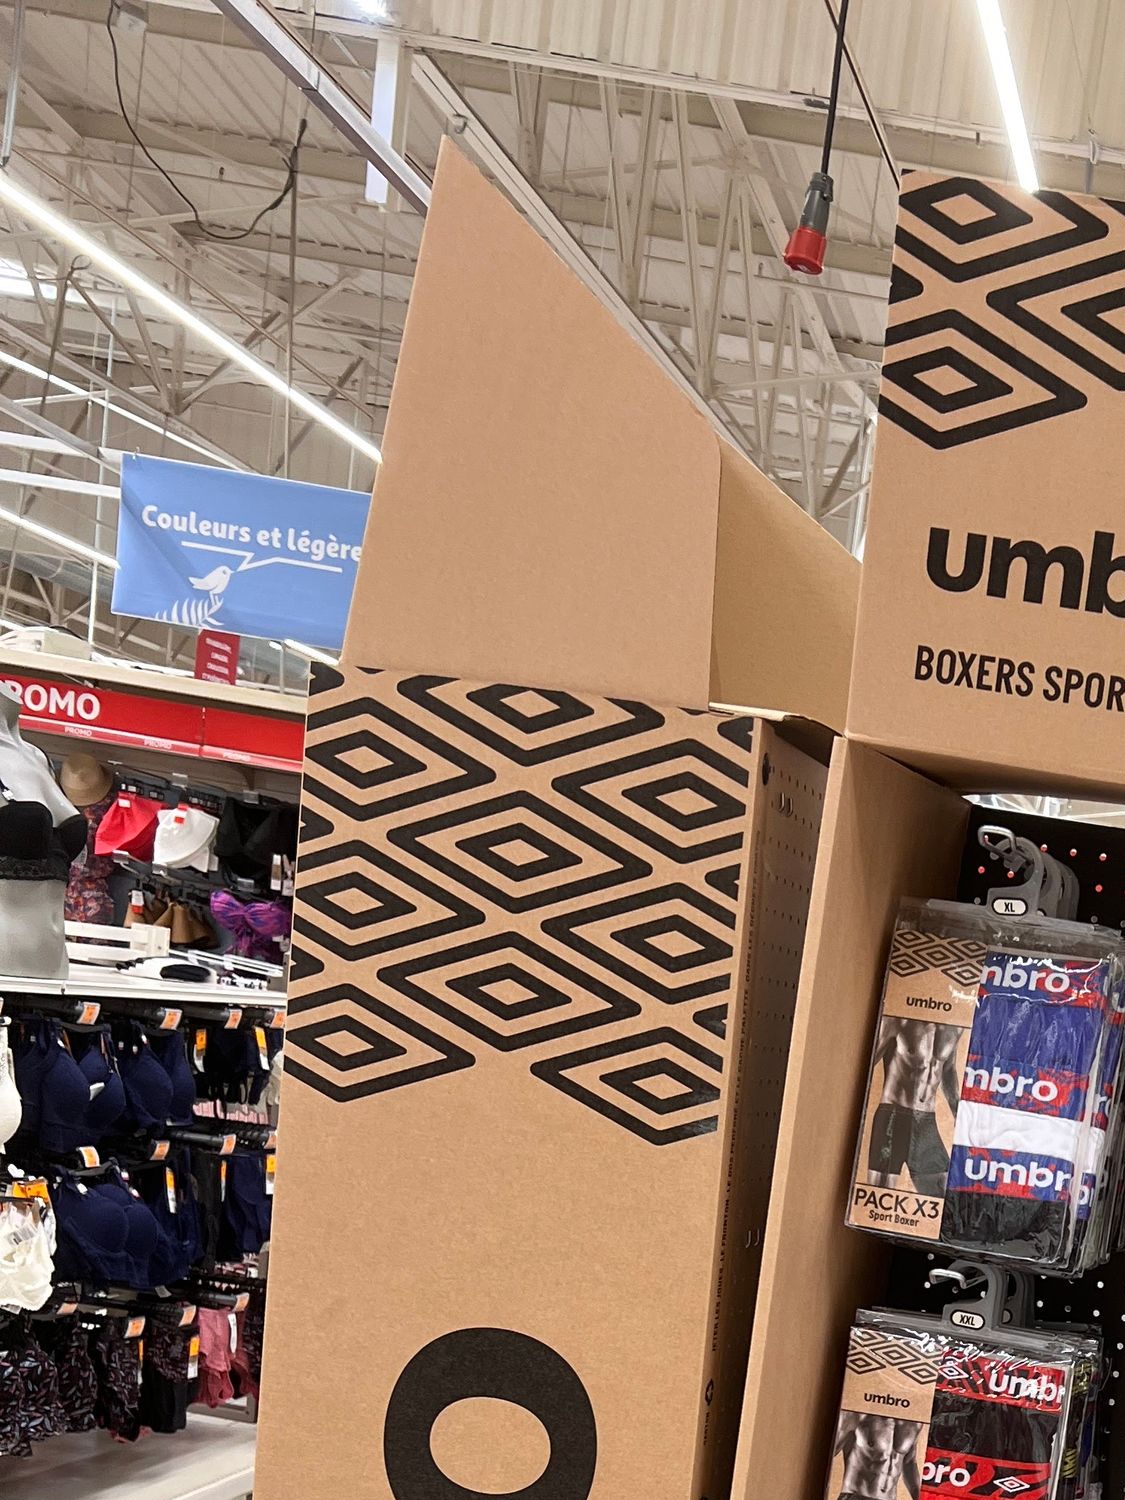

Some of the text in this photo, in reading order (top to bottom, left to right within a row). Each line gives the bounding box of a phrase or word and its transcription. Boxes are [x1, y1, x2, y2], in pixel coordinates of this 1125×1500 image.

[142, 505, 362, 561] Couleurs et légère
[914, 645, 1035, 697] BOXERS
[0, 680, 100, 720] ROMO
[1003, 901, 1016, 913] XL
[906, 996, 952, 1012] umbro
[854, 1188, 940, 1219] PACK X3
[868, 1210, 920, 1228] Sport Boxer
[959, 1314, 975, 1326] XXL
[864, 1393, 910, 1408] umbro
